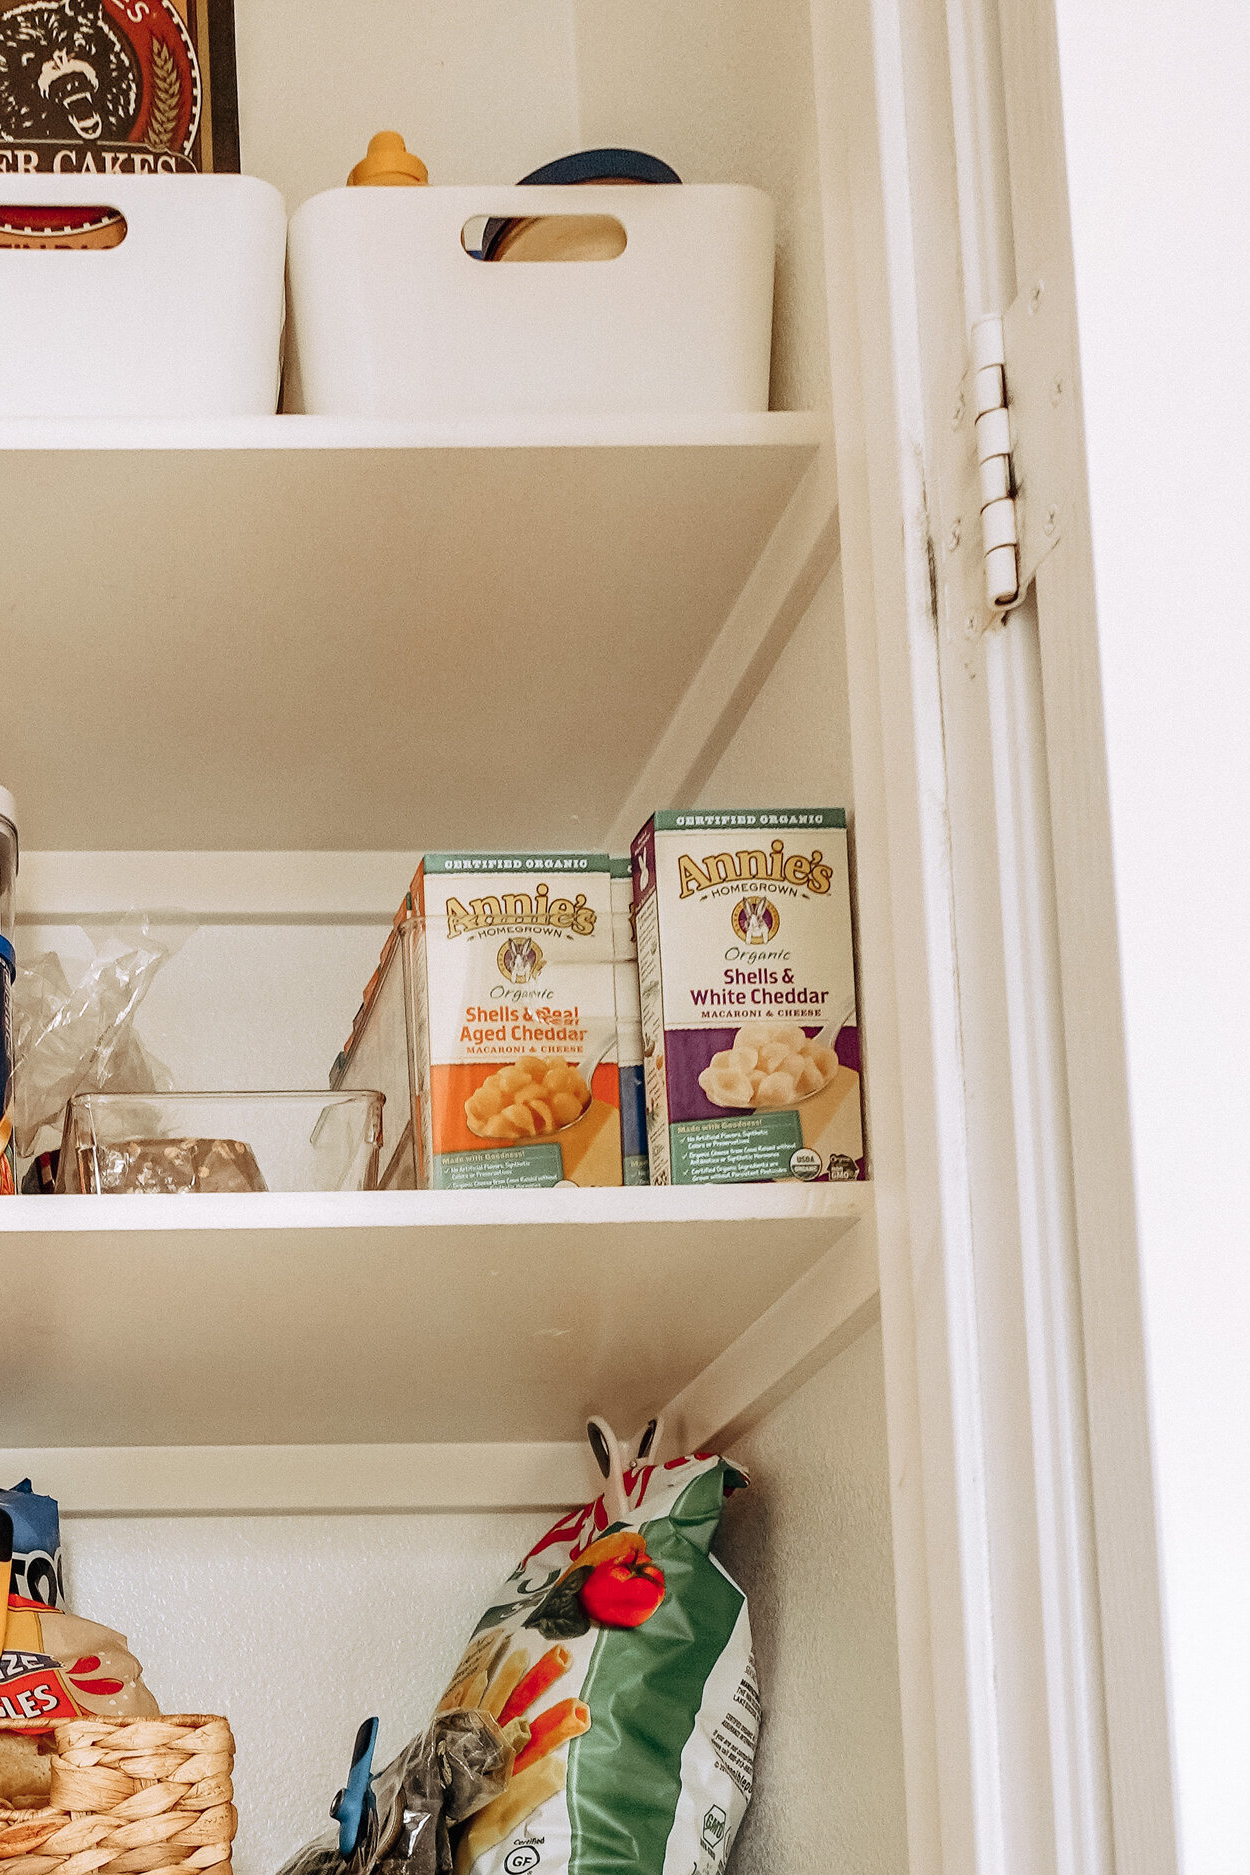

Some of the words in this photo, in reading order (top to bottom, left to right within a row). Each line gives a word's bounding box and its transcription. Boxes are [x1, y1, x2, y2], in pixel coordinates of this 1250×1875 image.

[676, 815, 756, 826] CERTIFIED
[760, 814, 823, 825] ORGANIC
[444, 859, 522, 870] CERTIFIED
[525, 859, 588, 869] ORGANIC
[678, 839, 834, 900] Annie's
[711, 882, 798, 898] HOMEGROWN
[446, 882, 597, 939] Annie's
[477, 926, 563, 940] HOMEGROWN
[724, 947, 791, 965] Organic
[724, 968, 779, 985] Shells
[781, 968, 795, 985] &
[690, 989, 746, 1006] White
[750, 987, 830, 1005] Cheddar
[466, 1005, 520, 1023] Shells
[701, 1009, 762, 1019] MACARONI
[777, 1008, 822, 1018] CHEESE
[460, 1025, 507, 1045] Aged
[510, 1024, 588, 1042] Cheddar
[512, 1855, 533, 1867] GF
